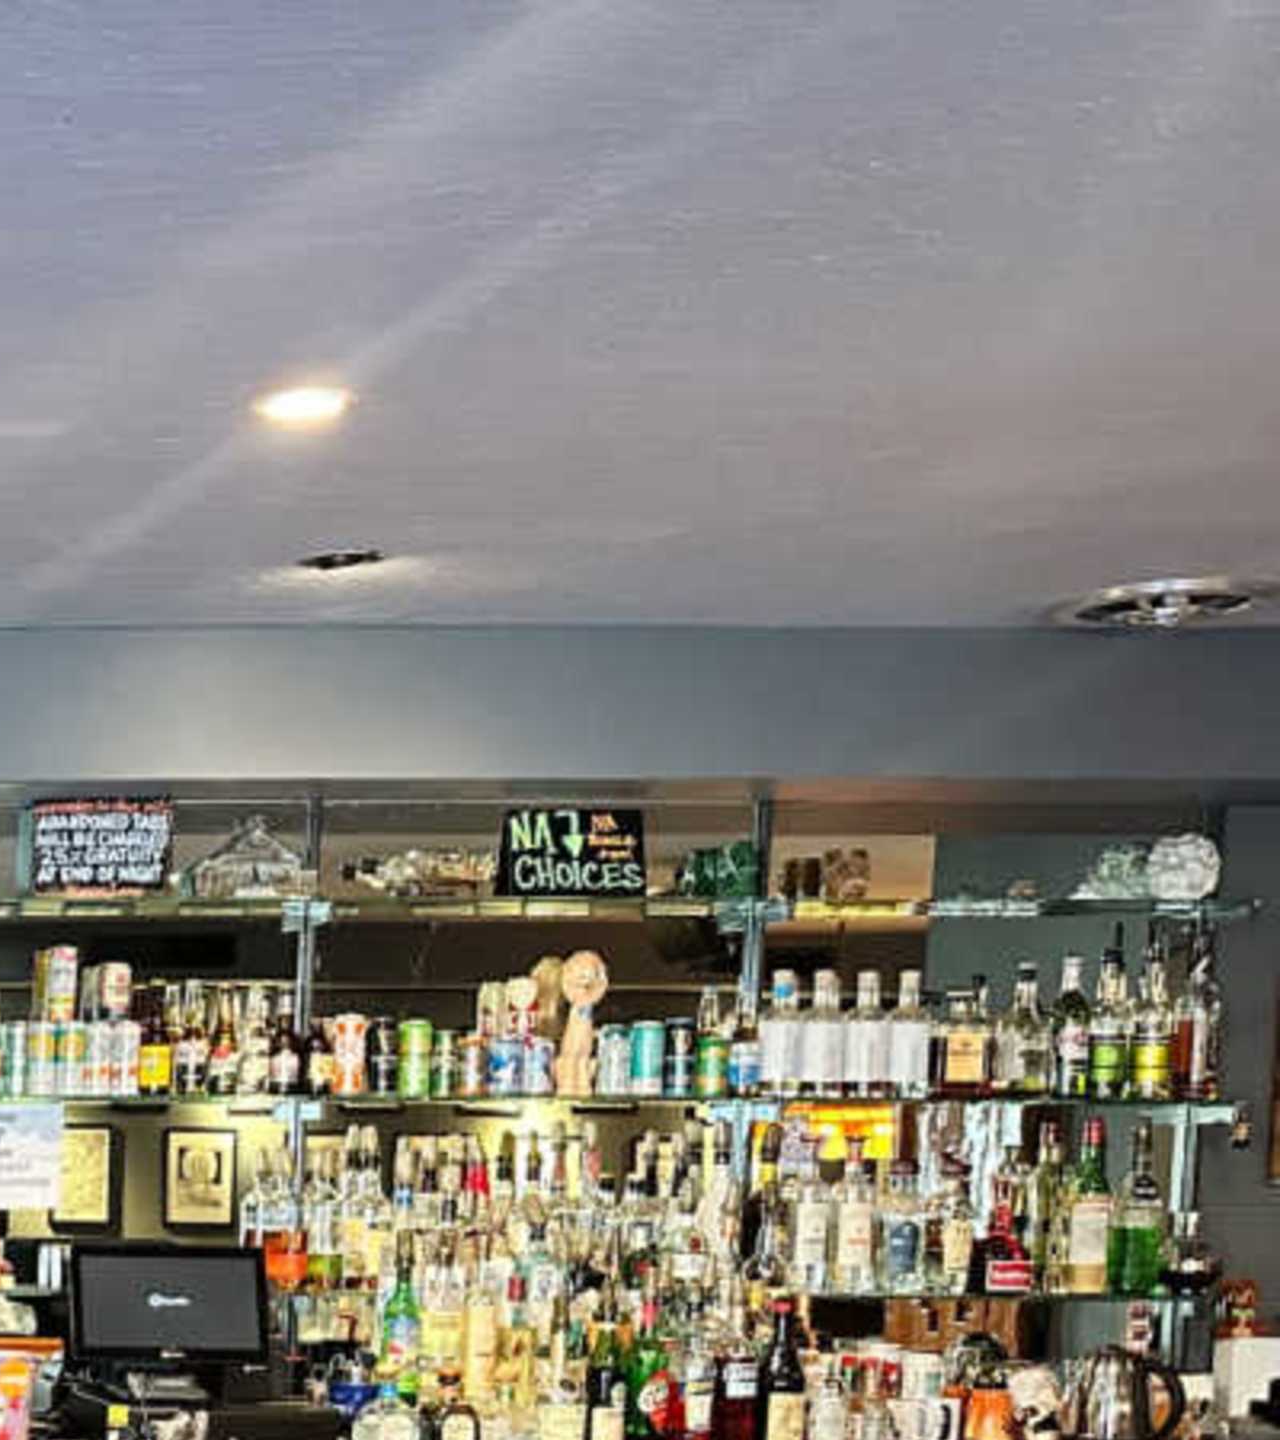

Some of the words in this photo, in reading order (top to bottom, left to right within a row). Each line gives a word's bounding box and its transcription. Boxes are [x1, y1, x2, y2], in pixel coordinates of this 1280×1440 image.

[37, 812, 130, 830] ABANDONED
[72, 830, 96, 847] BE
[509, 811, 558, 854] NA
[60, 866, 93, 883] END
[514, 854, 644, 890] CHOICES
